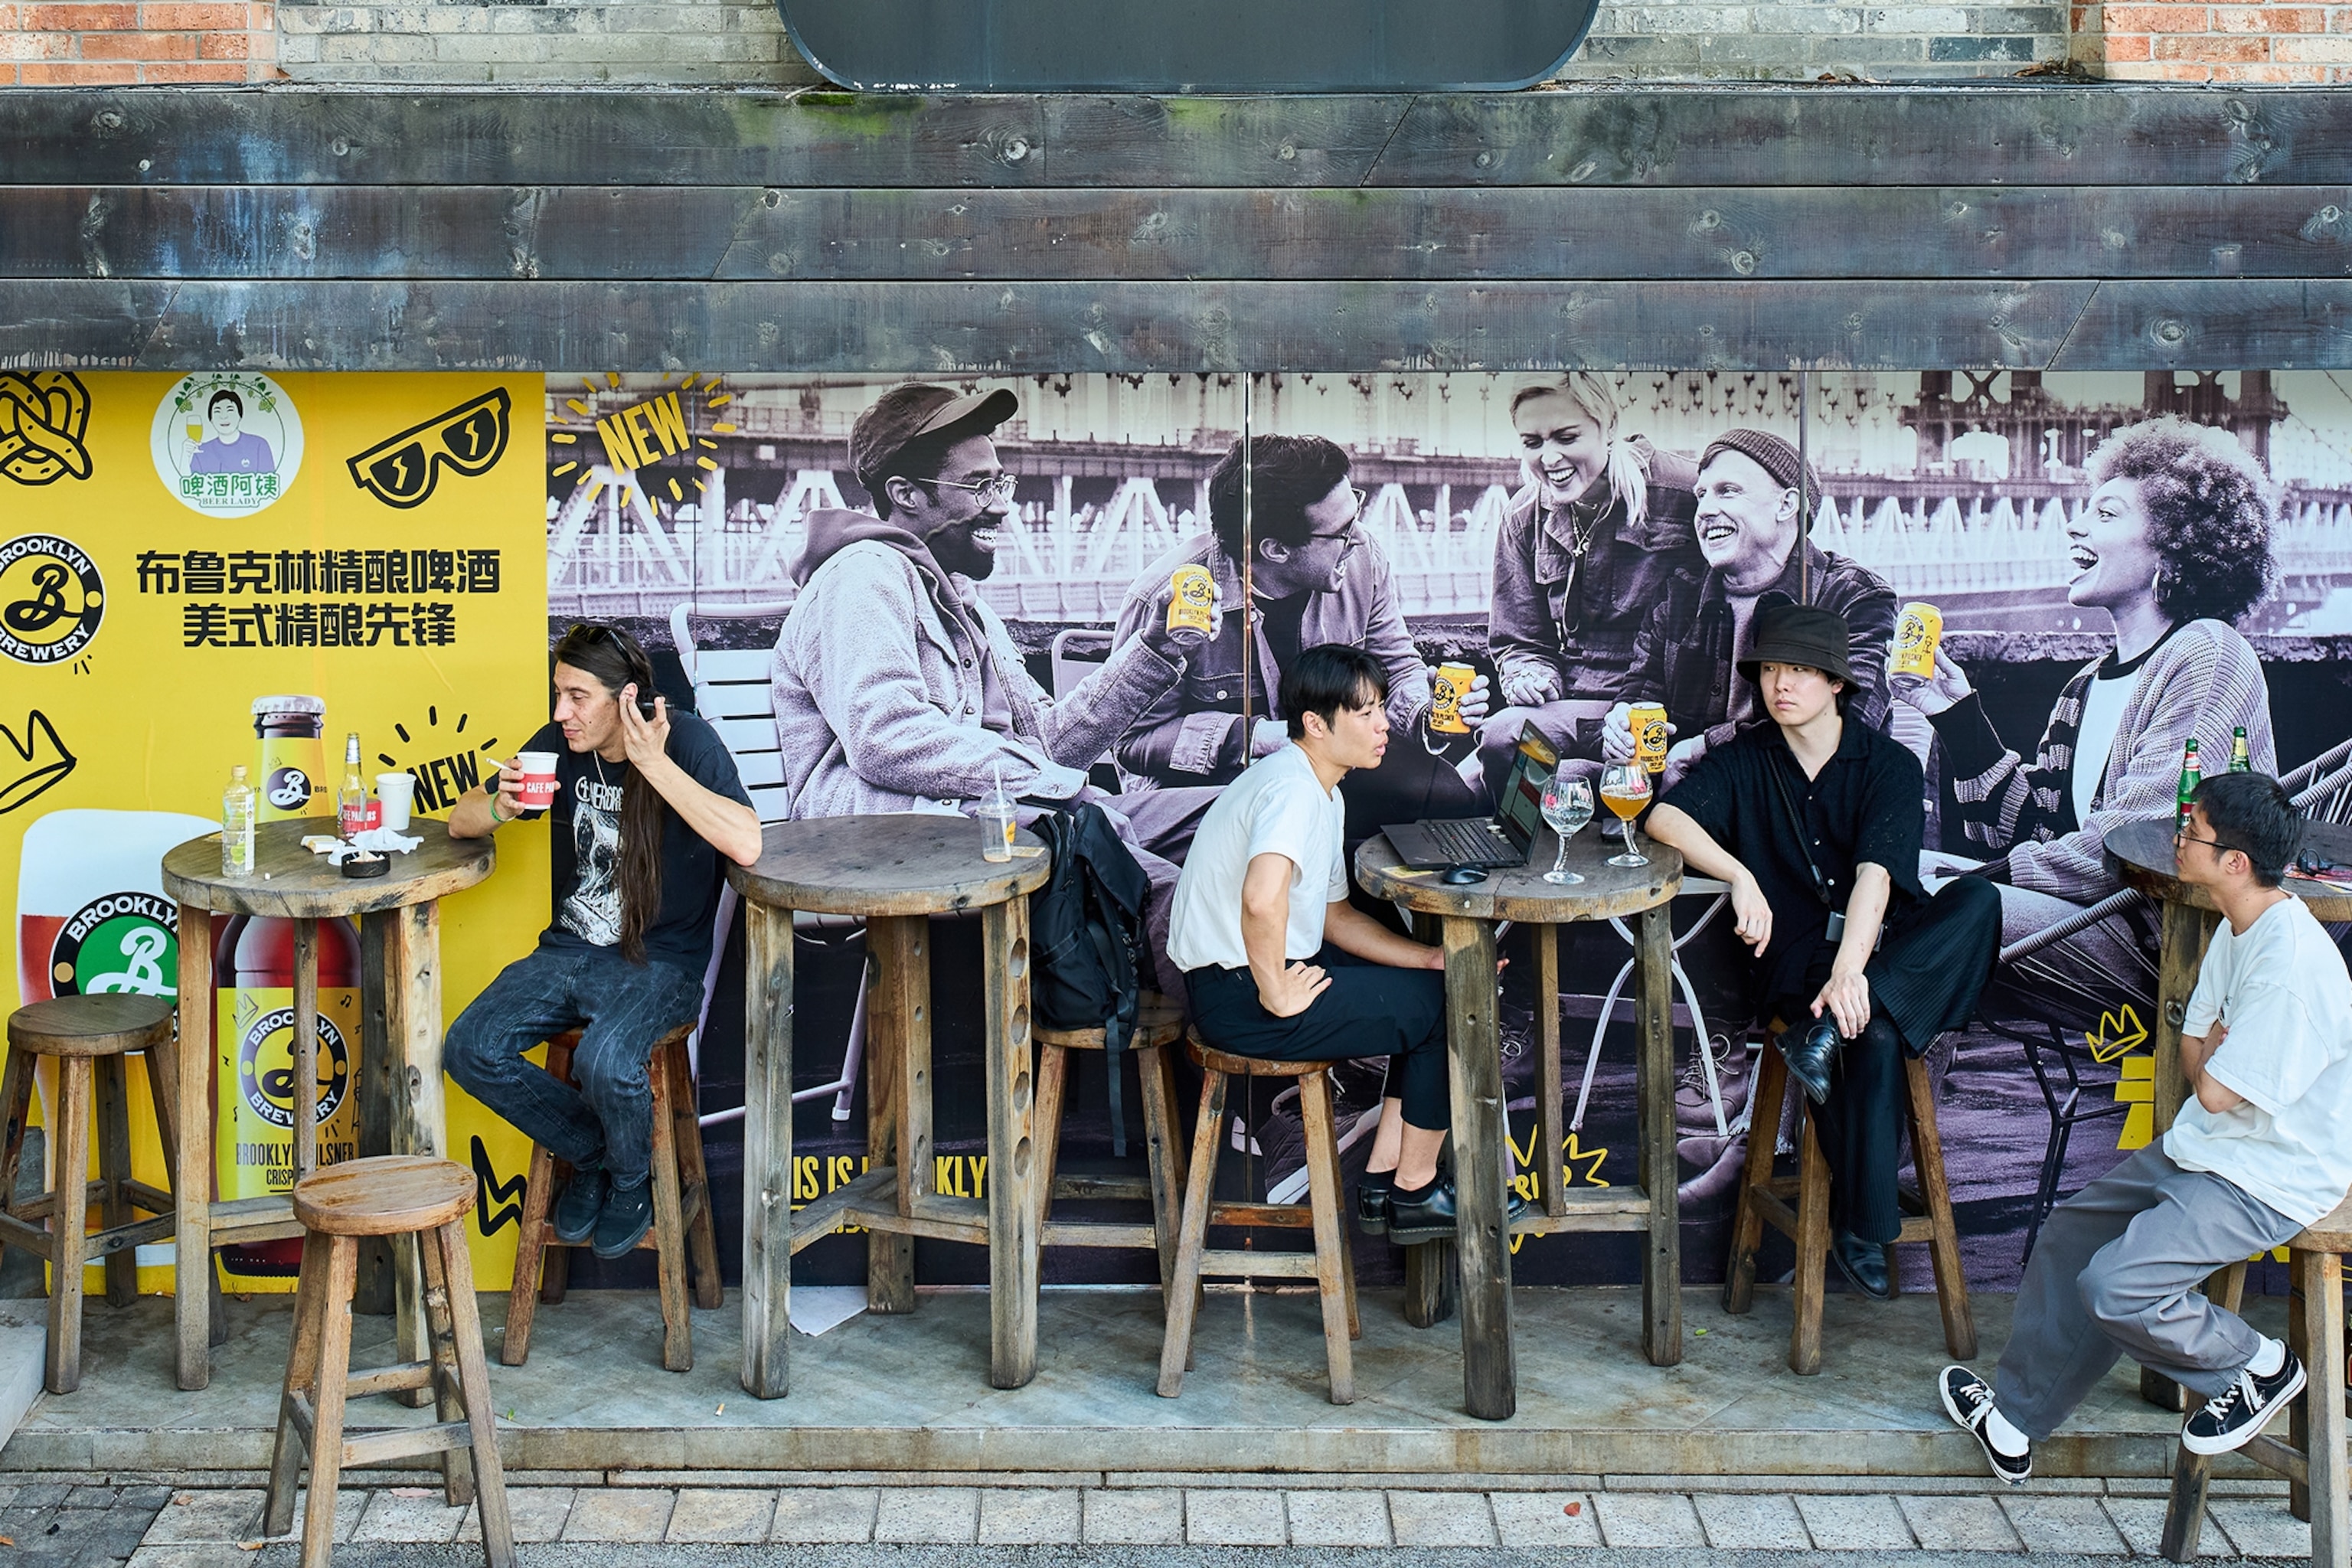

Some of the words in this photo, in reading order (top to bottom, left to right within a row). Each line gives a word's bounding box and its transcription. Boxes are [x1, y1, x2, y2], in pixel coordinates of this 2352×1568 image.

[595, 390, 691, 475] NEW
[182, 475, 278, 497] 啤酒阿姨
[0, 538, 91, 576] ROOKLYN
[136, 549, 501, 595] 布鲁克林精酿啤酒
[183, 602, 456, 648] 美式精酿先锋
[406, 750, 480, 815] NEW
[526, 782, 544, 793] CAFE
[66, 895, 178, 943] BROOKLY
[248, 1011, 339, 1047] BROOYN
[315, 1142, 354, 1166] ILSNER
[266, 1168, 294, 1186] CRISP
